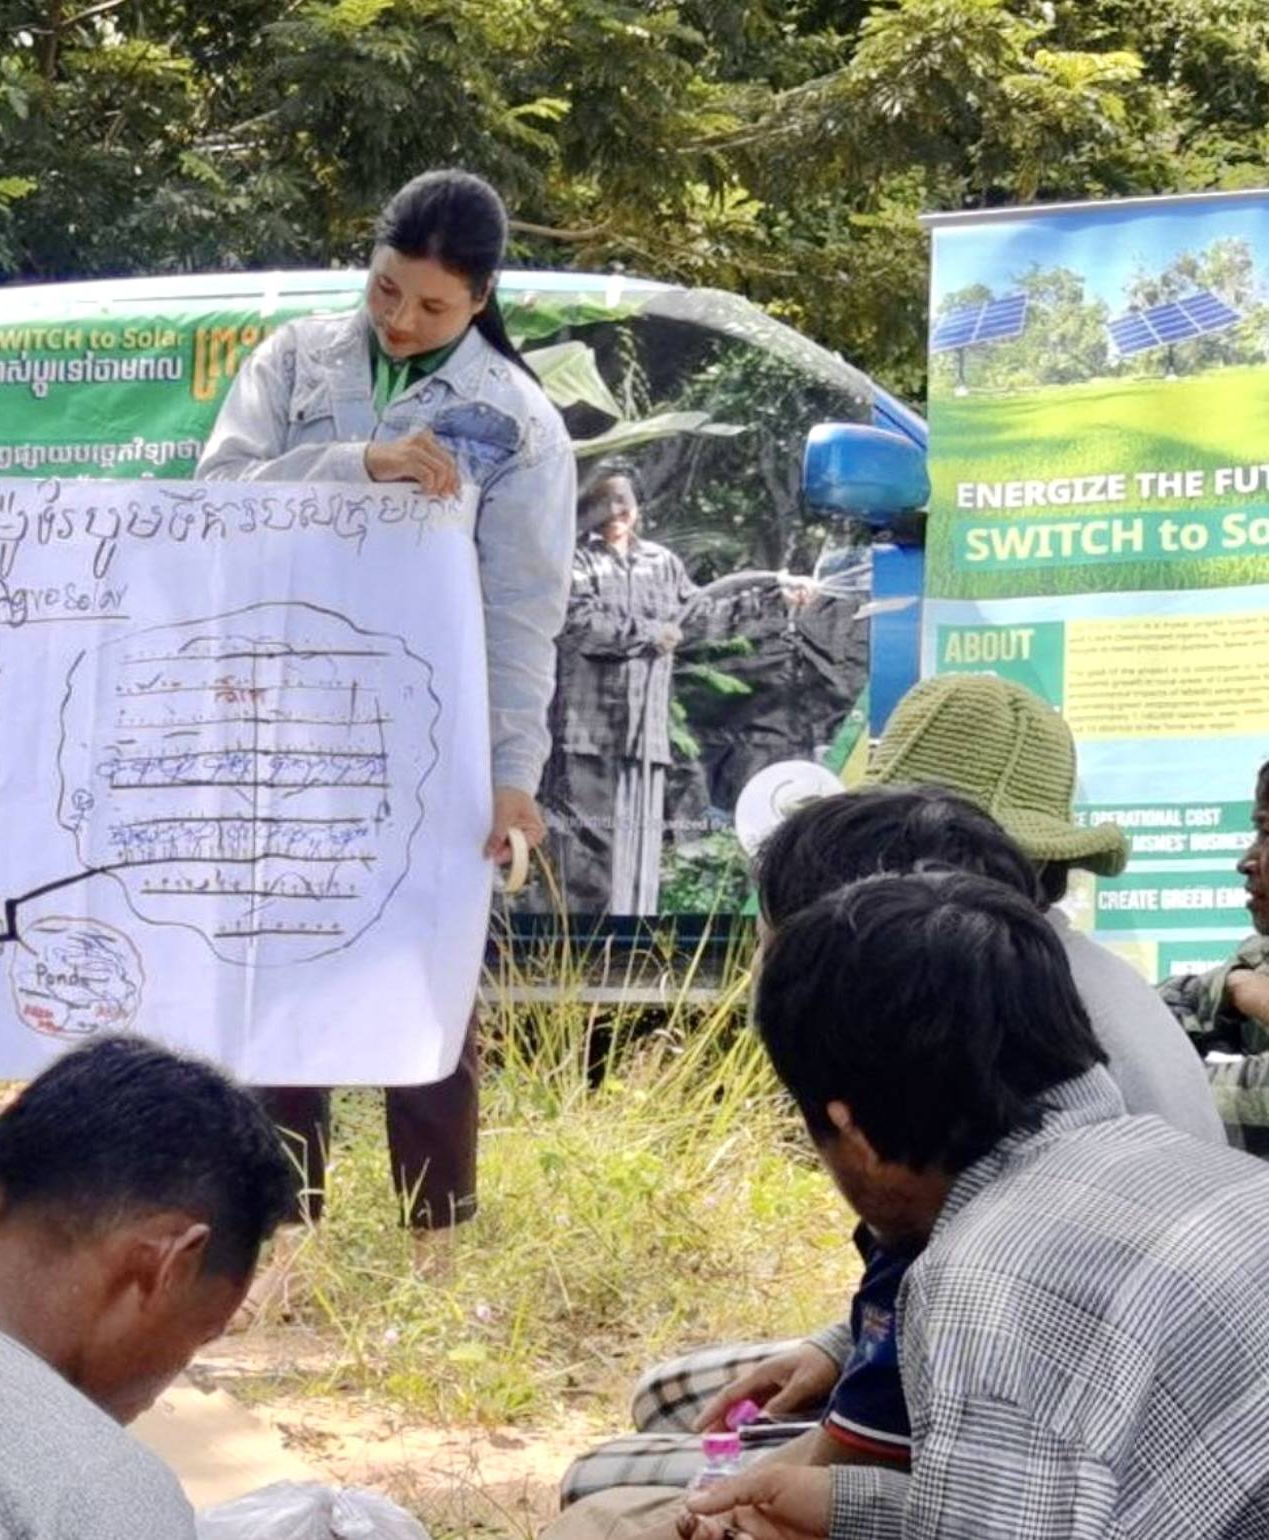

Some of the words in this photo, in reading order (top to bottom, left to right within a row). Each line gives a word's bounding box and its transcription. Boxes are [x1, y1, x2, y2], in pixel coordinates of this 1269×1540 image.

[90, 328, 116, 349] to
[122, 325, 186, 349] Solar
[956, 473, 1127, 509] ENERGIZE
[1136, 470, 1205, 498] THE
[1215, 464, 1269, 495] FUT
[964, 518, 1143, 562] SWITCH
[1158, 522, 1209, 551] to
[1222, 512, 1269, 549] So
[944, 629, 1035, 663] ABOUT
